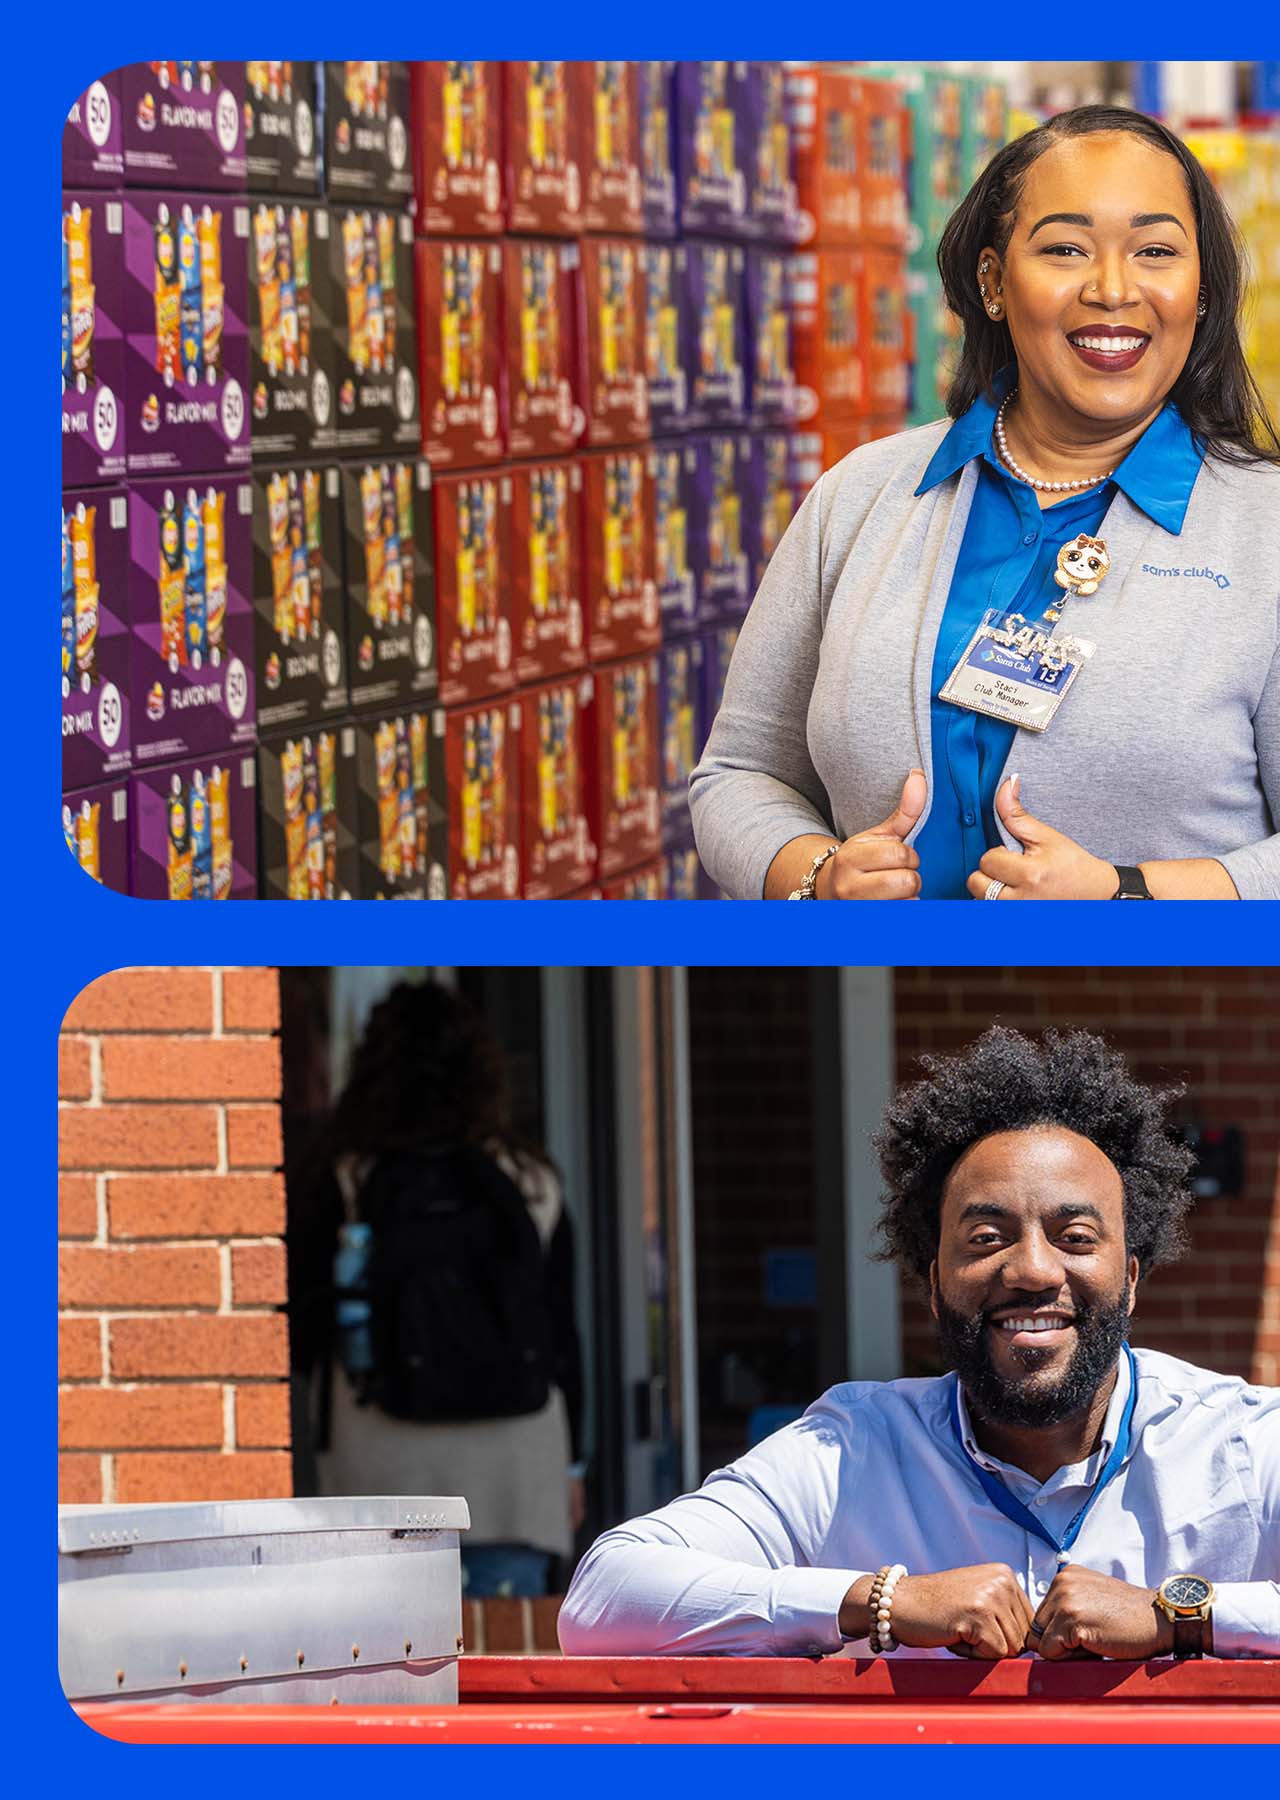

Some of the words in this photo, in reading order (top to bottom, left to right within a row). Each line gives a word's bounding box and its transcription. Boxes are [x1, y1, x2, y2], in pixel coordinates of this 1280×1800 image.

[91, 97, 106, 124] 50
[99, 402, 113, 428] 50
[226, 395, 241, 419] 50
[72, 412, 88, 432] MIX
[1142, 564, 1180, 577] sam's
[1013, 661, 1031, 673] Club
[1039, 667, 1058, 683] 13
[229, 672, 244, 698] 50
[974, 683, 993, 696] Club
[996, 690, 1030, 708] Manager
[76, 711, 93, 733] MIX
[103, 698, 117, 725] 50
